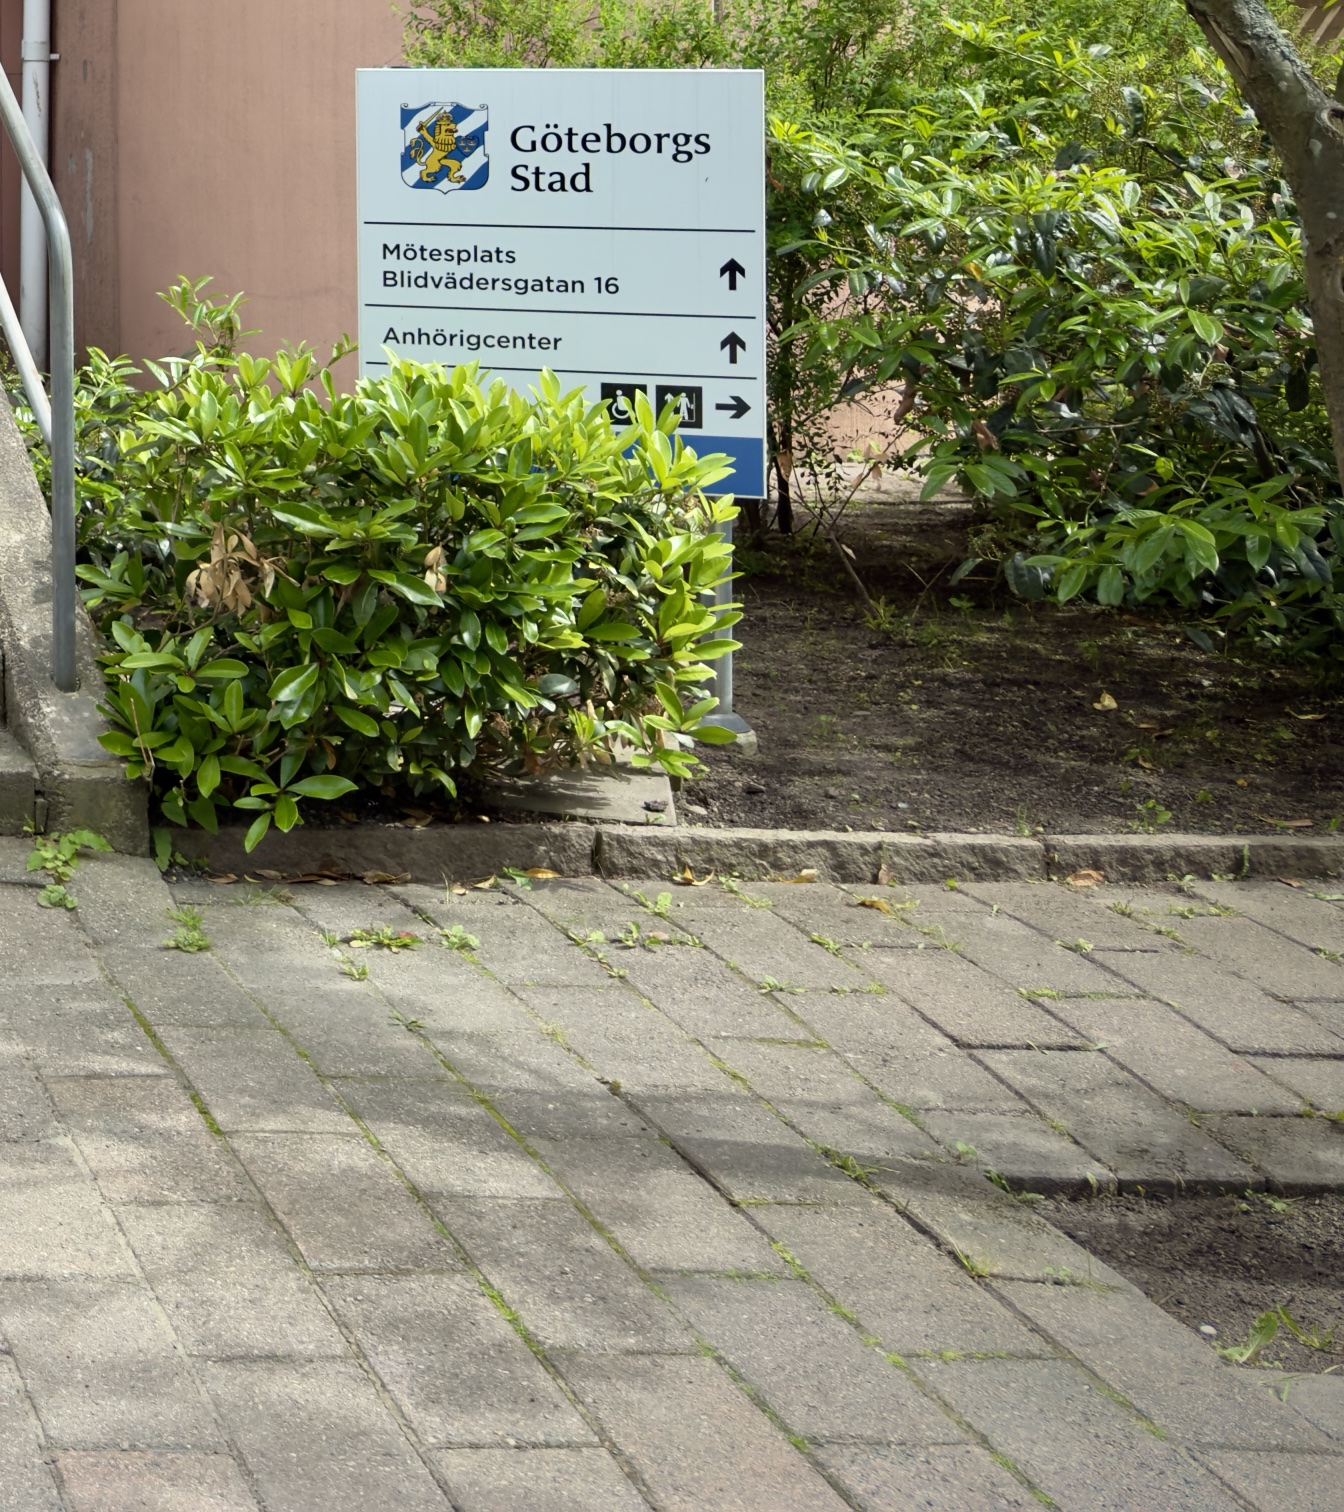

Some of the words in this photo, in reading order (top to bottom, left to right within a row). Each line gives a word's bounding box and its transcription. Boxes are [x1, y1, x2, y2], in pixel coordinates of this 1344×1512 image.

[510, 123, 711, 164] Göteborgs
[510, 162, 594, 193] Stad
[381, 243, 517, 266] Mötesplats
[382, 270, 585, 295] Blidvädersgatan
[593, 276, 620, 295] 16
[382, 326, 563, 351] Anhörigcenter
